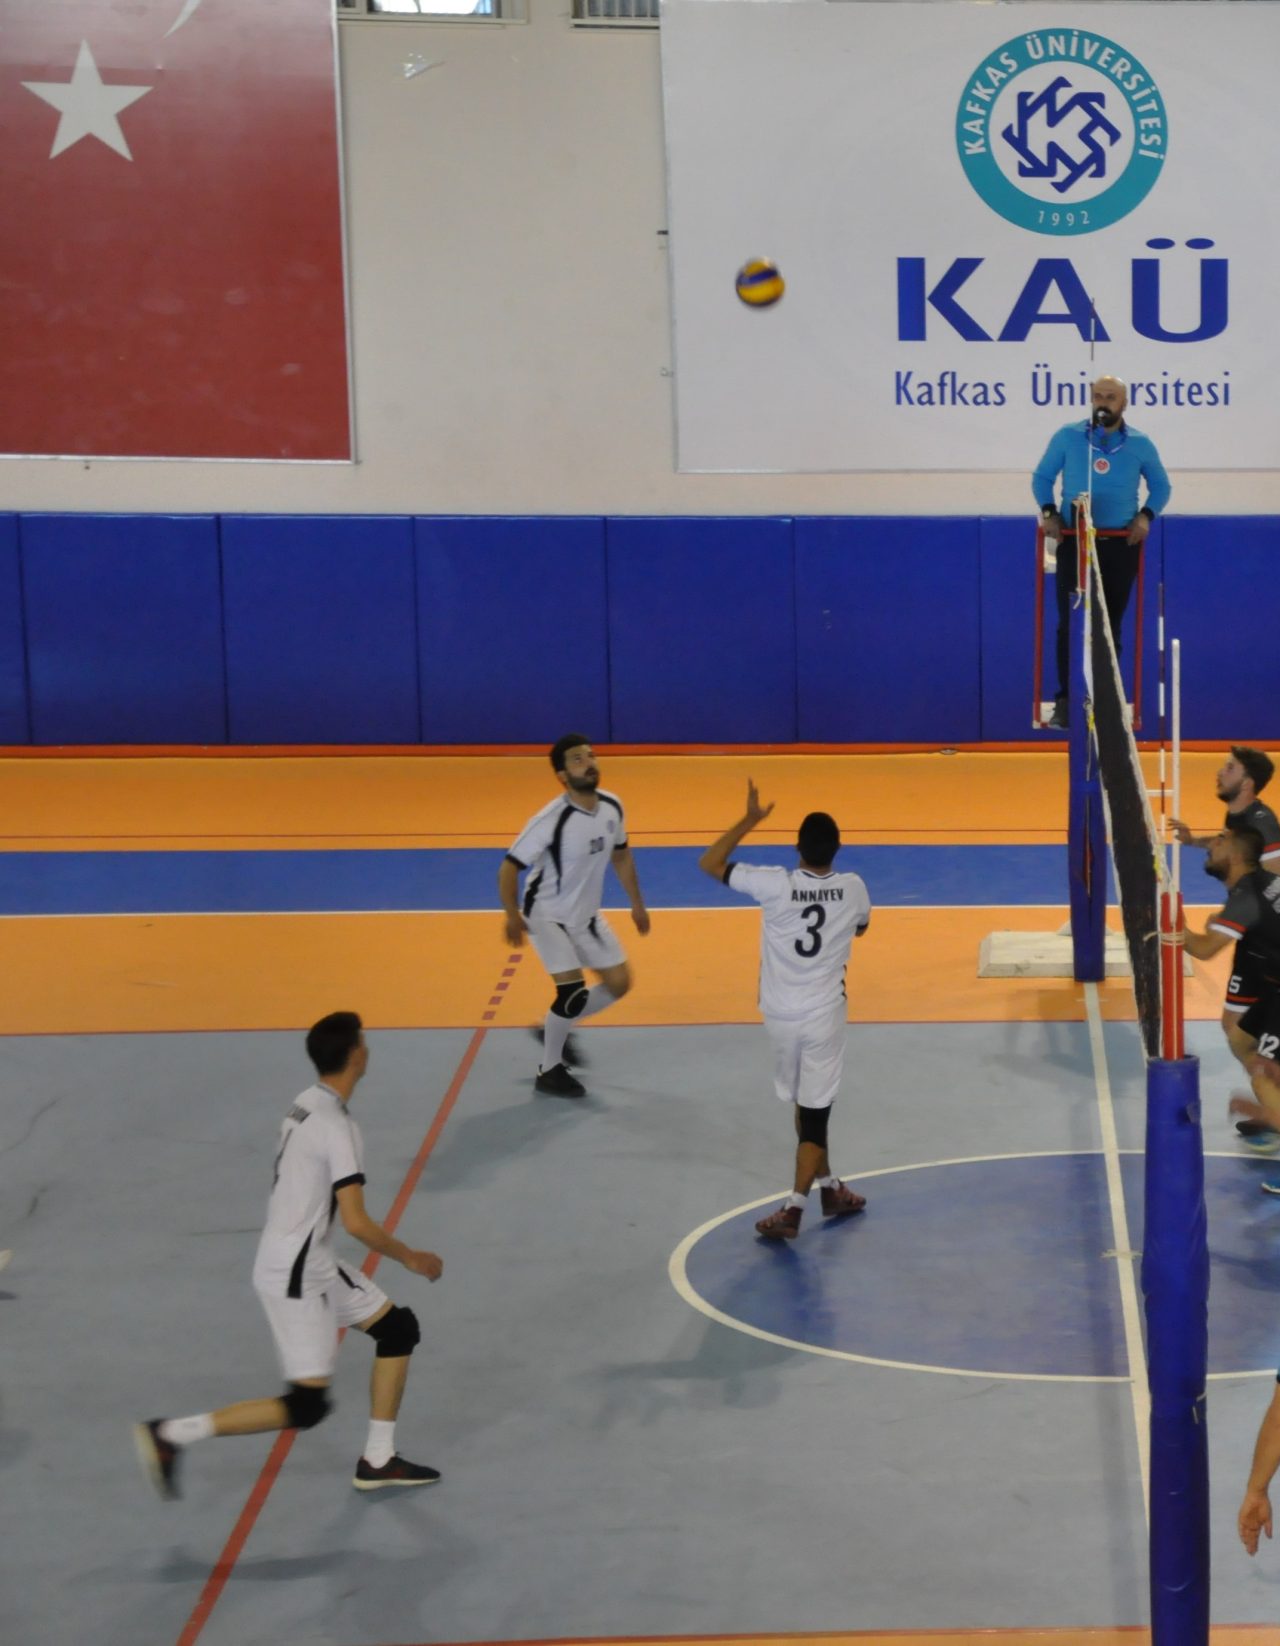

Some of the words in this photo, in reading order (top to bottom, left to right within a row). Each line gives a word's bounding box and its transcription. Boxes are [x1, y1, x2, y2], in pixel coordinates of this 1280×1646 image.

[963, 52, 1018, 155] KAFKAS
[1025, 30, 1164, 160] ÜNİVERSİTESİ
[1038, 210, 1090, 226] 1992
[897, 238, 1229, 343] KAÜ
[895, 371, 1006, 406] Kafkas
[1032, 363, 1230, 406] Ünirsitesi
[791, 888, 844, 903] ANNAYEV
[795, 903, 826, 958] 3
[1228, 975, 1242, 994] 5
[1258, 1032, 1280, 1060] 12
